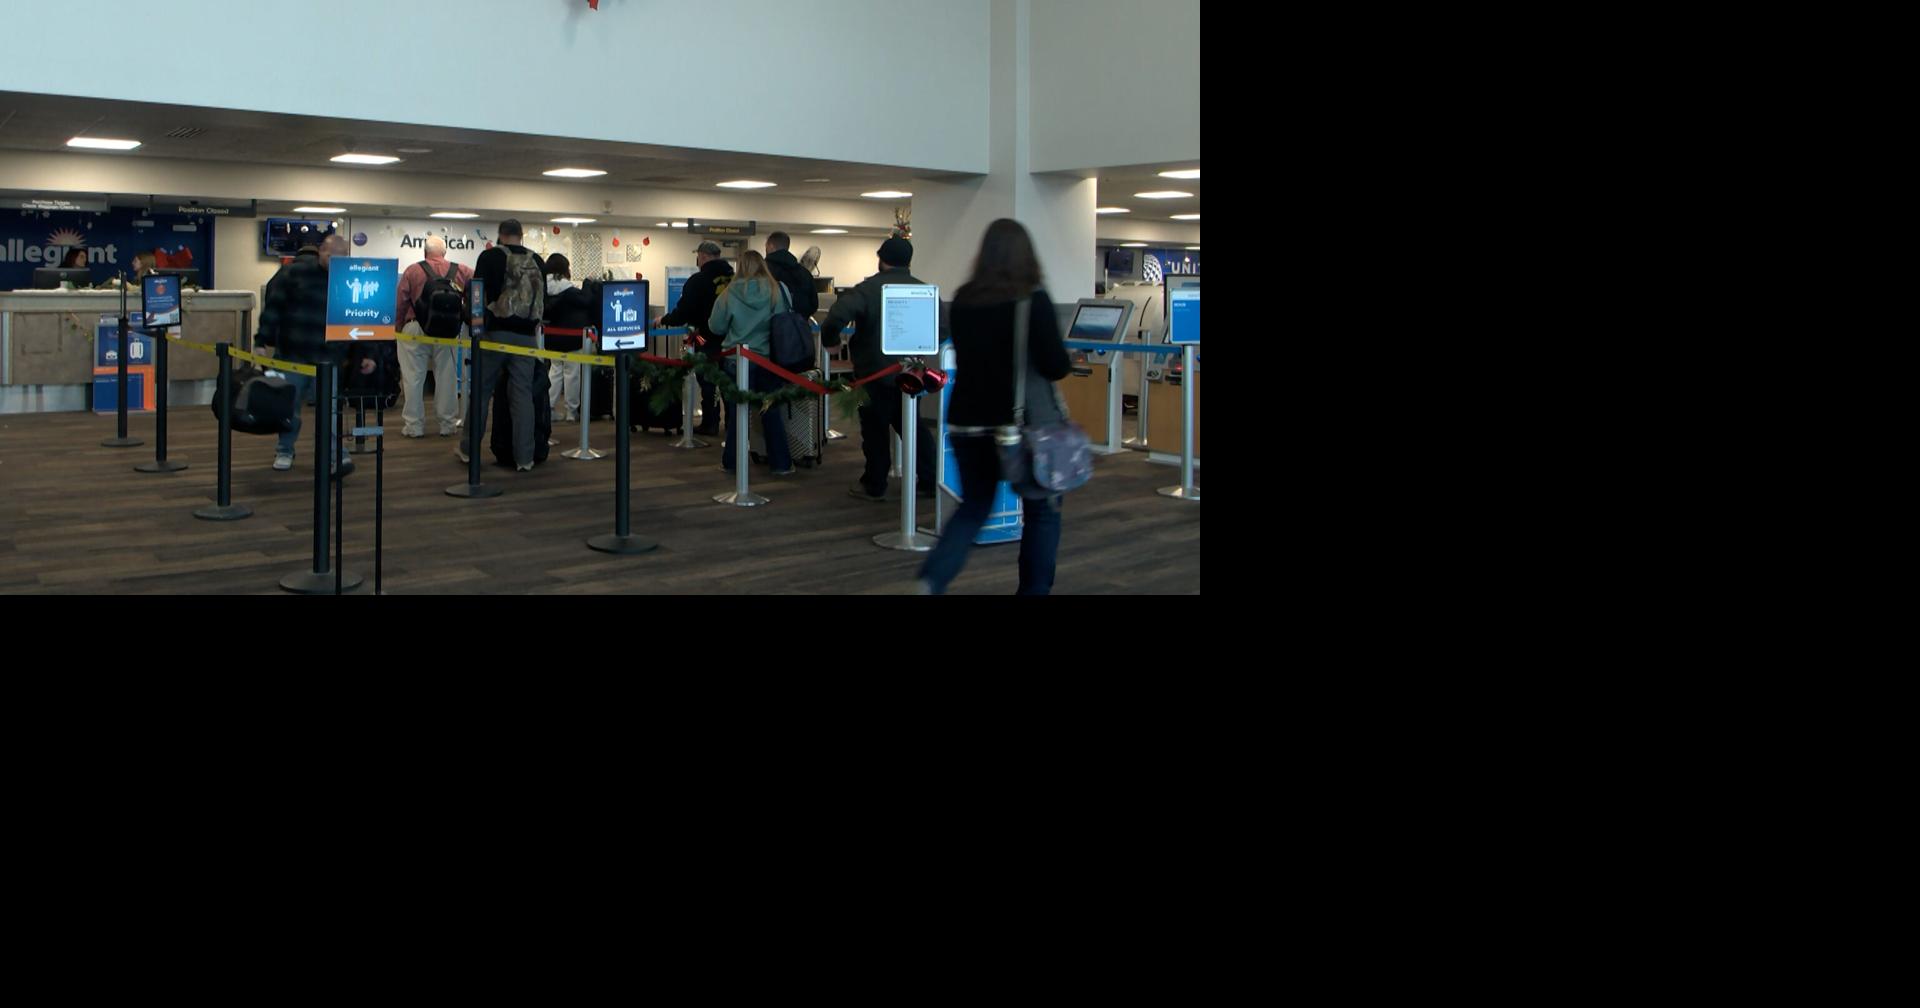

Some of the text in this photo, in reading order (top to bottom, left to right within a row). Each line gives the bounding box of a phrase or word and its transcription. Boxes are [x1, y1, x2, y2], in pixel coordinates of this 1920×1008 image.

[178, 206, 229, 215] Position Closed
[400, 234, 475, 250] Amican
[349, 264, 379, 273] allegiant
[345, 309, 379, 318] Priority
